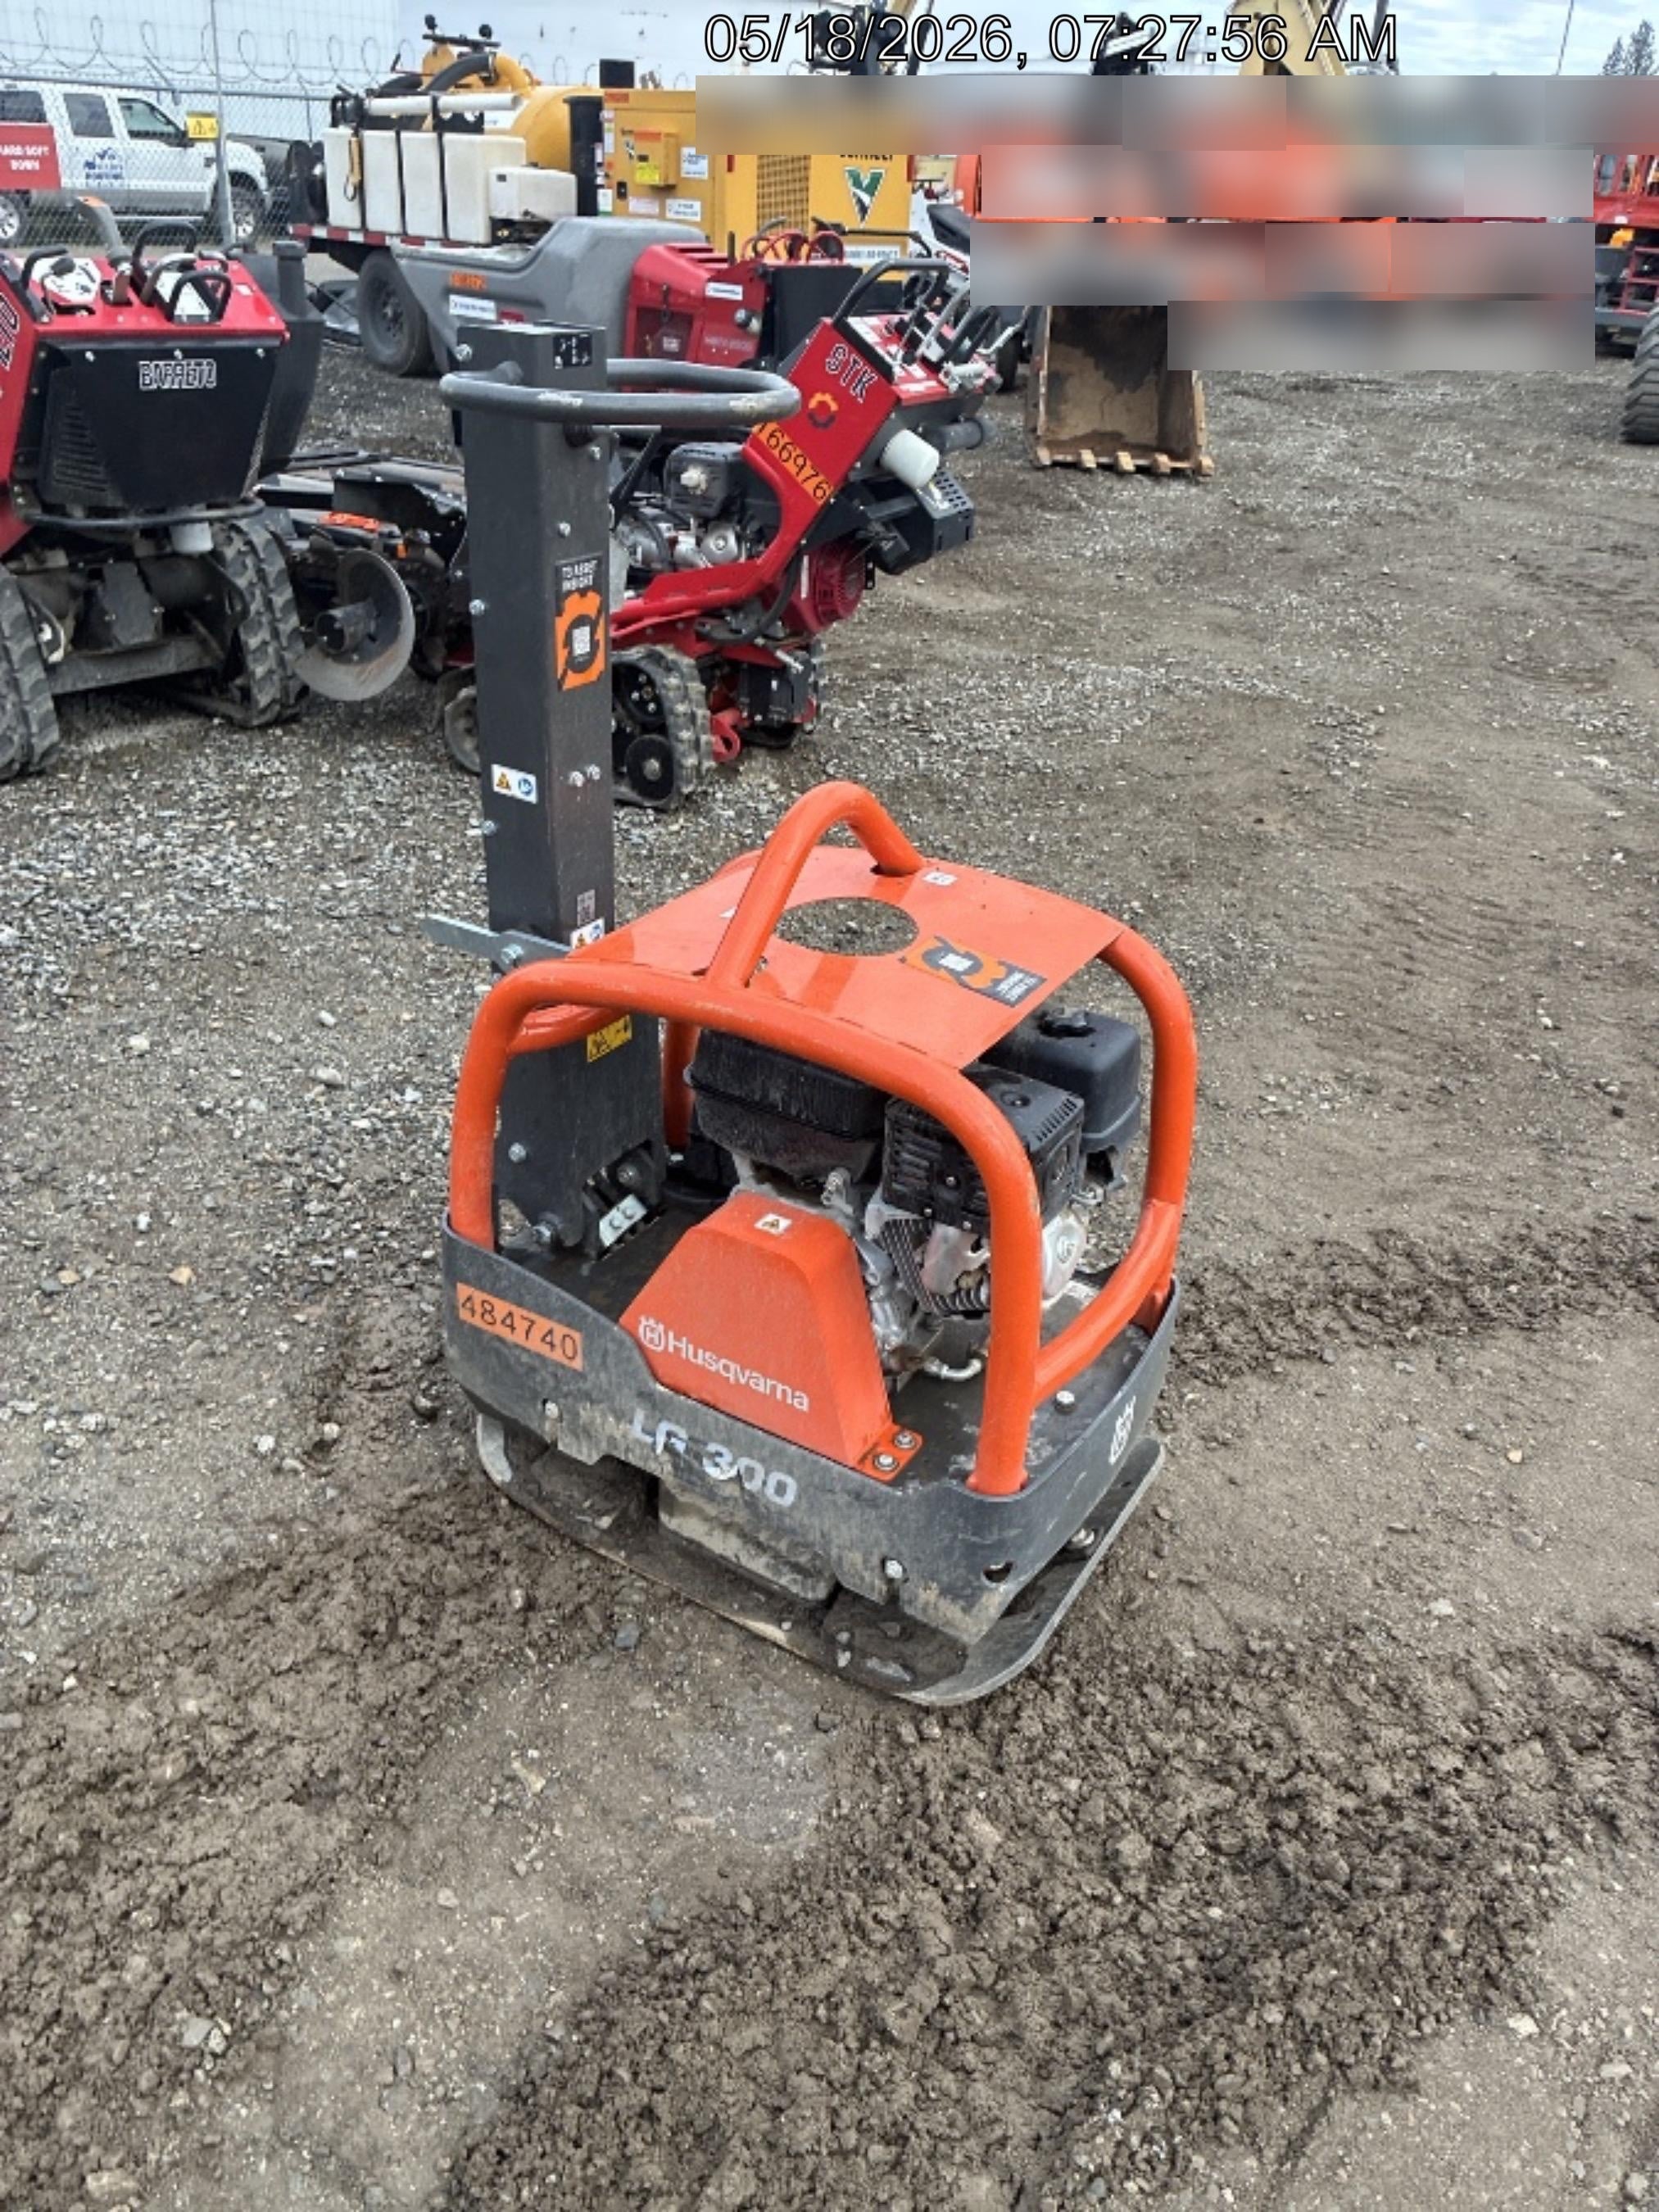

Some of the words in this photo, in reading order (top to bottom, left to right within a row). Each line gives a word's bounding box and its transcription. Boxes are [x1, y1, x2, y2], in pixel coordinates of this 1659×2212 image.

[826, 343, 878, 403] STK
[460, 1294, 578, 1361] 484740
[668, 1330, 810, 1412] Husqvarna
[702, 1443, 798, 1507] 300
